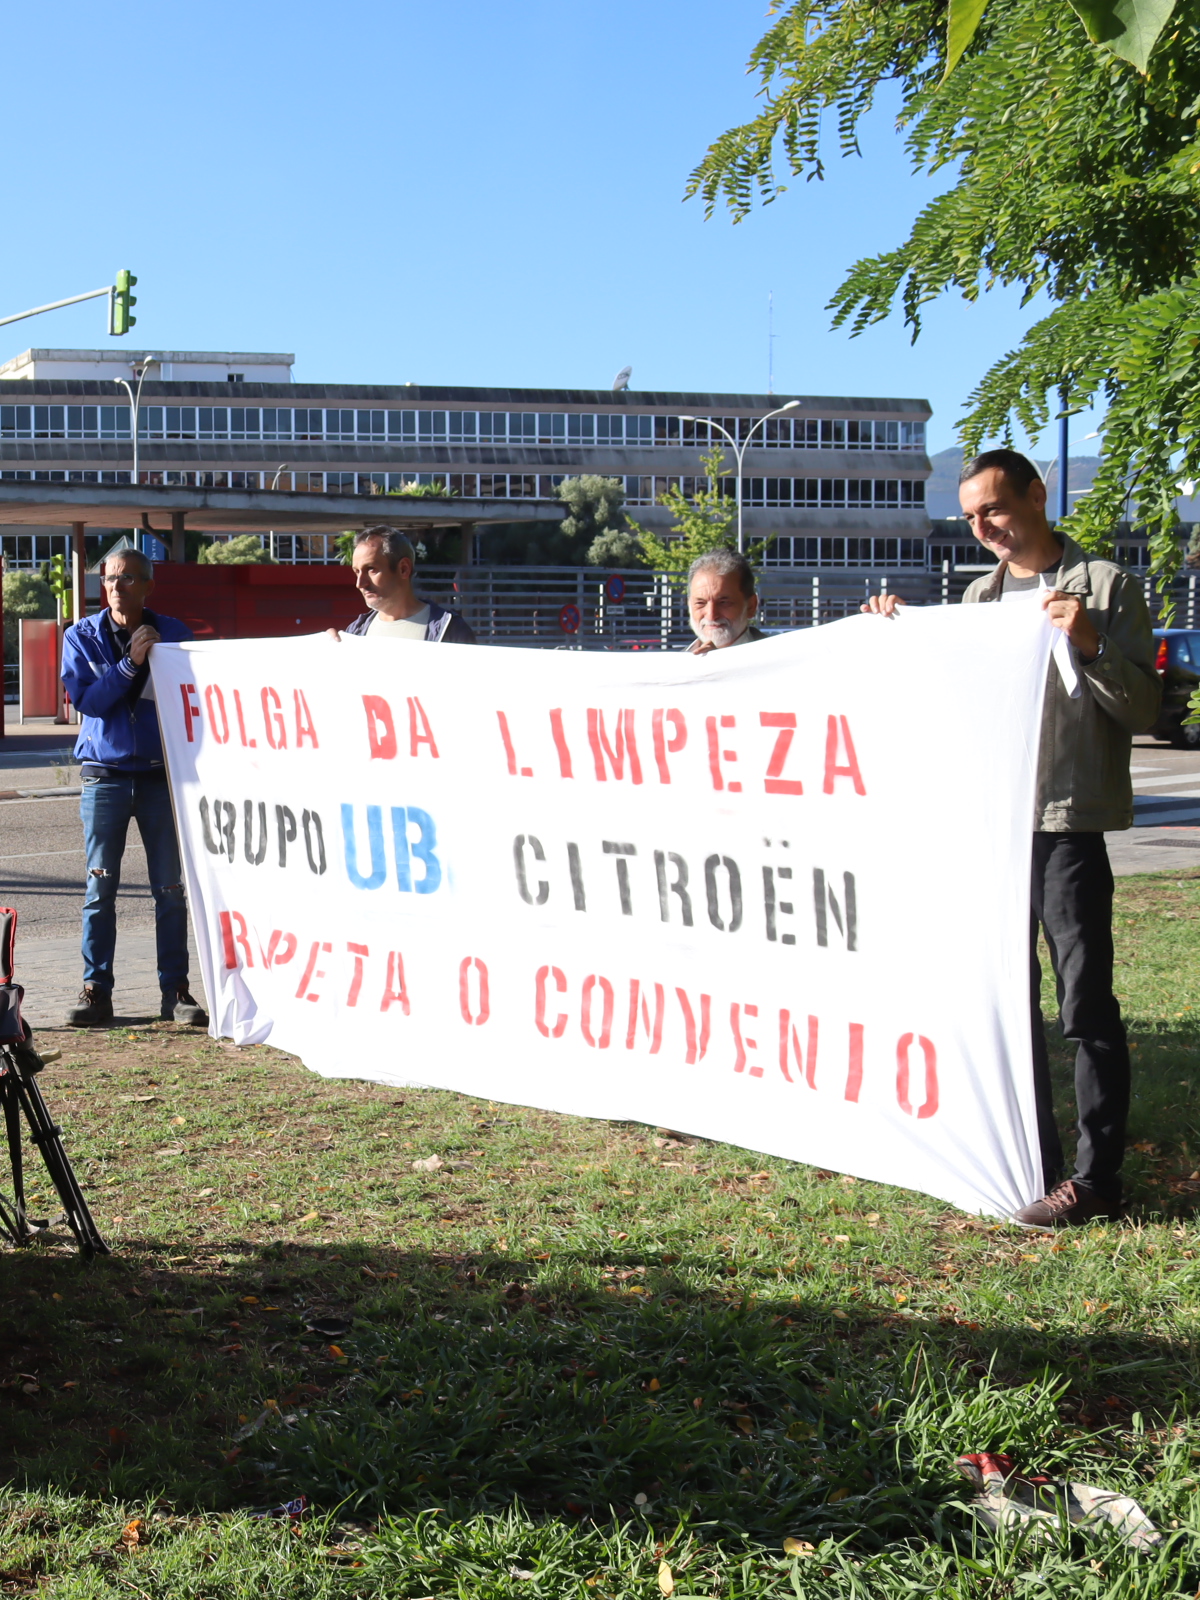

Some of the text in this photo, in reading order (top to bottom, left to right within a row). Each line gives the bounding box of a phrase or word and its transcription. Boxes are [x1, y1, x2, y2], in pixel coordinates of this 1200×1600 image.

[180, 683, 867, 796] FOLGA DA LIMPEZA
[340, 803, 442, 895] UB
[513, 834, 858, 952] CITROËN
[459, 956, 490, 1026] O
[534, 965, 939, 1119] CONVENIO
